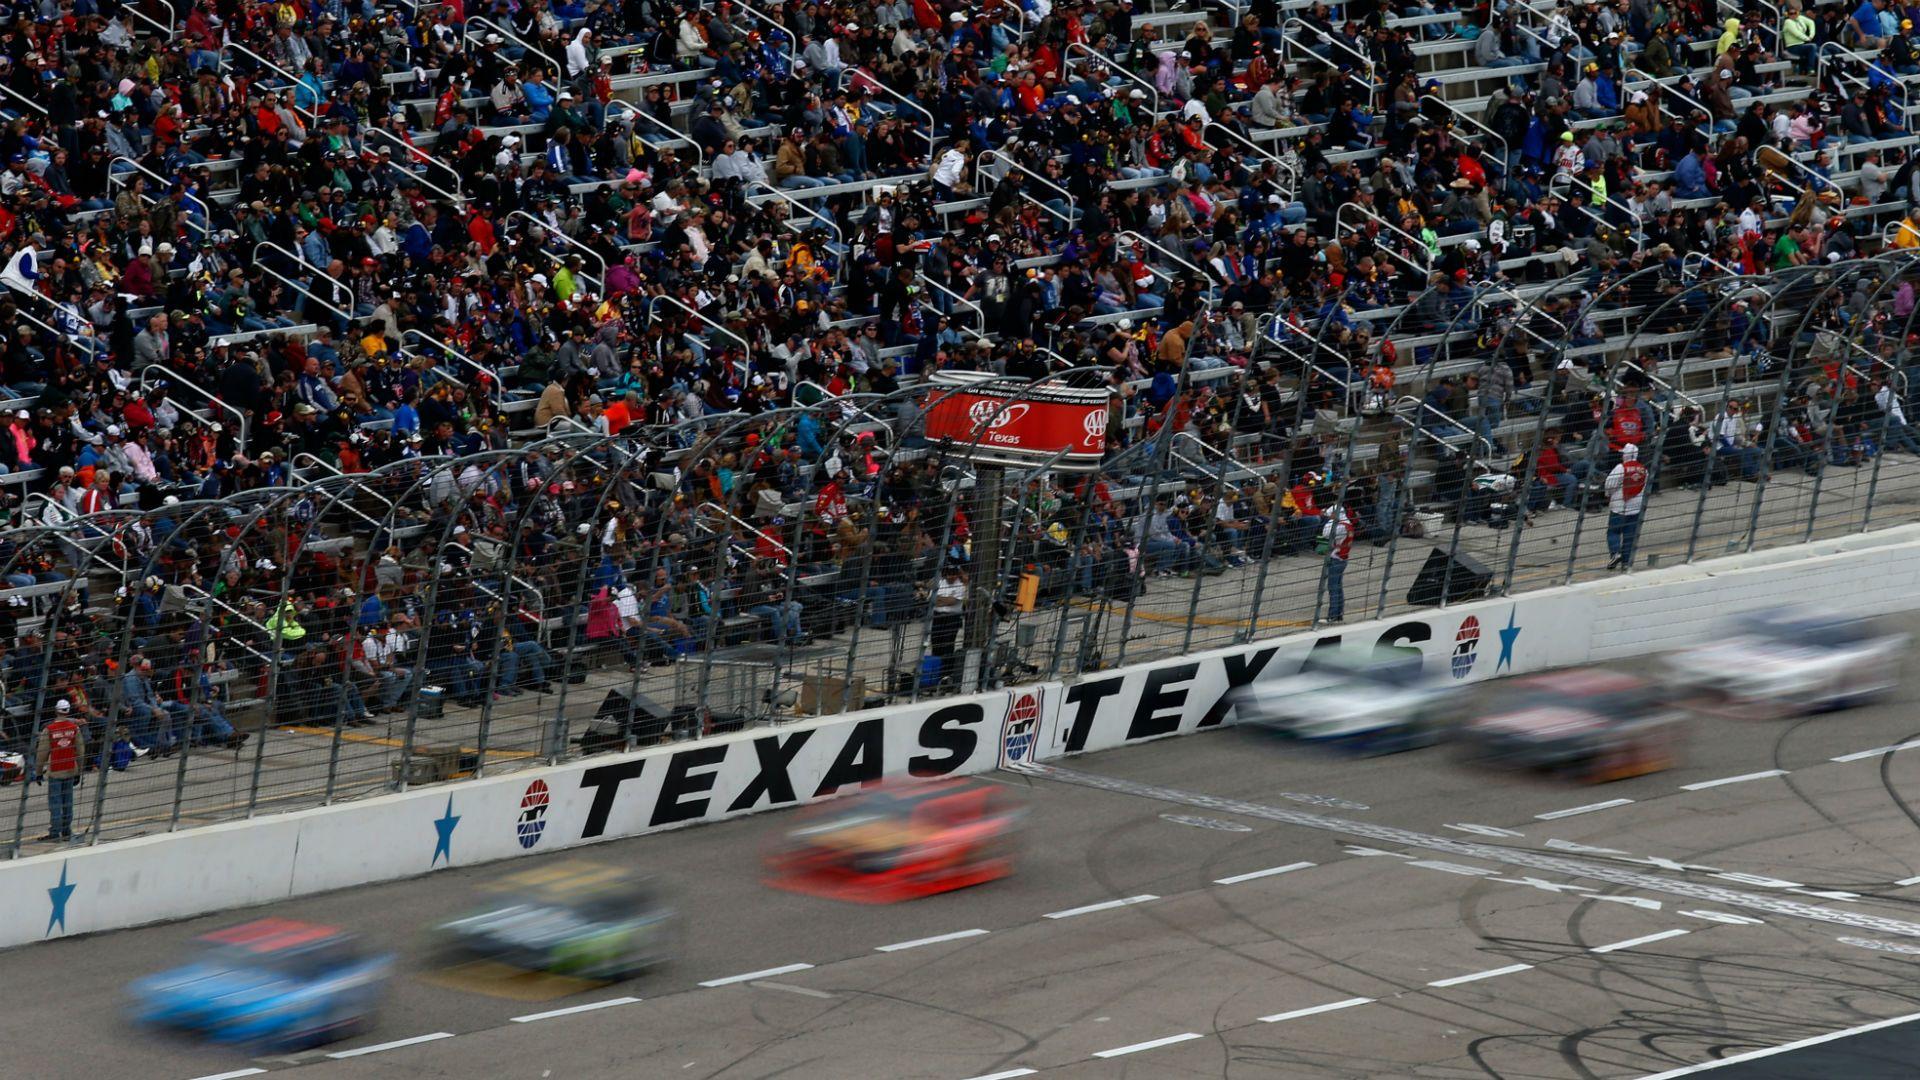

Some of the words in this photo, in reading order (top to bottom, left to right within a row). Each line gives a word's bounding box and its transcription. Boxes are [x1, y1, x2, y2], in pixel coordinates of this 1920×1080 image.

[988, 431, 1021, 444] Texas
[580, 703, 984, 839] TEXAS
[1341, 844, 1765, 924] TEXAS
[1441, 823, 1862, 902] TEXAS
